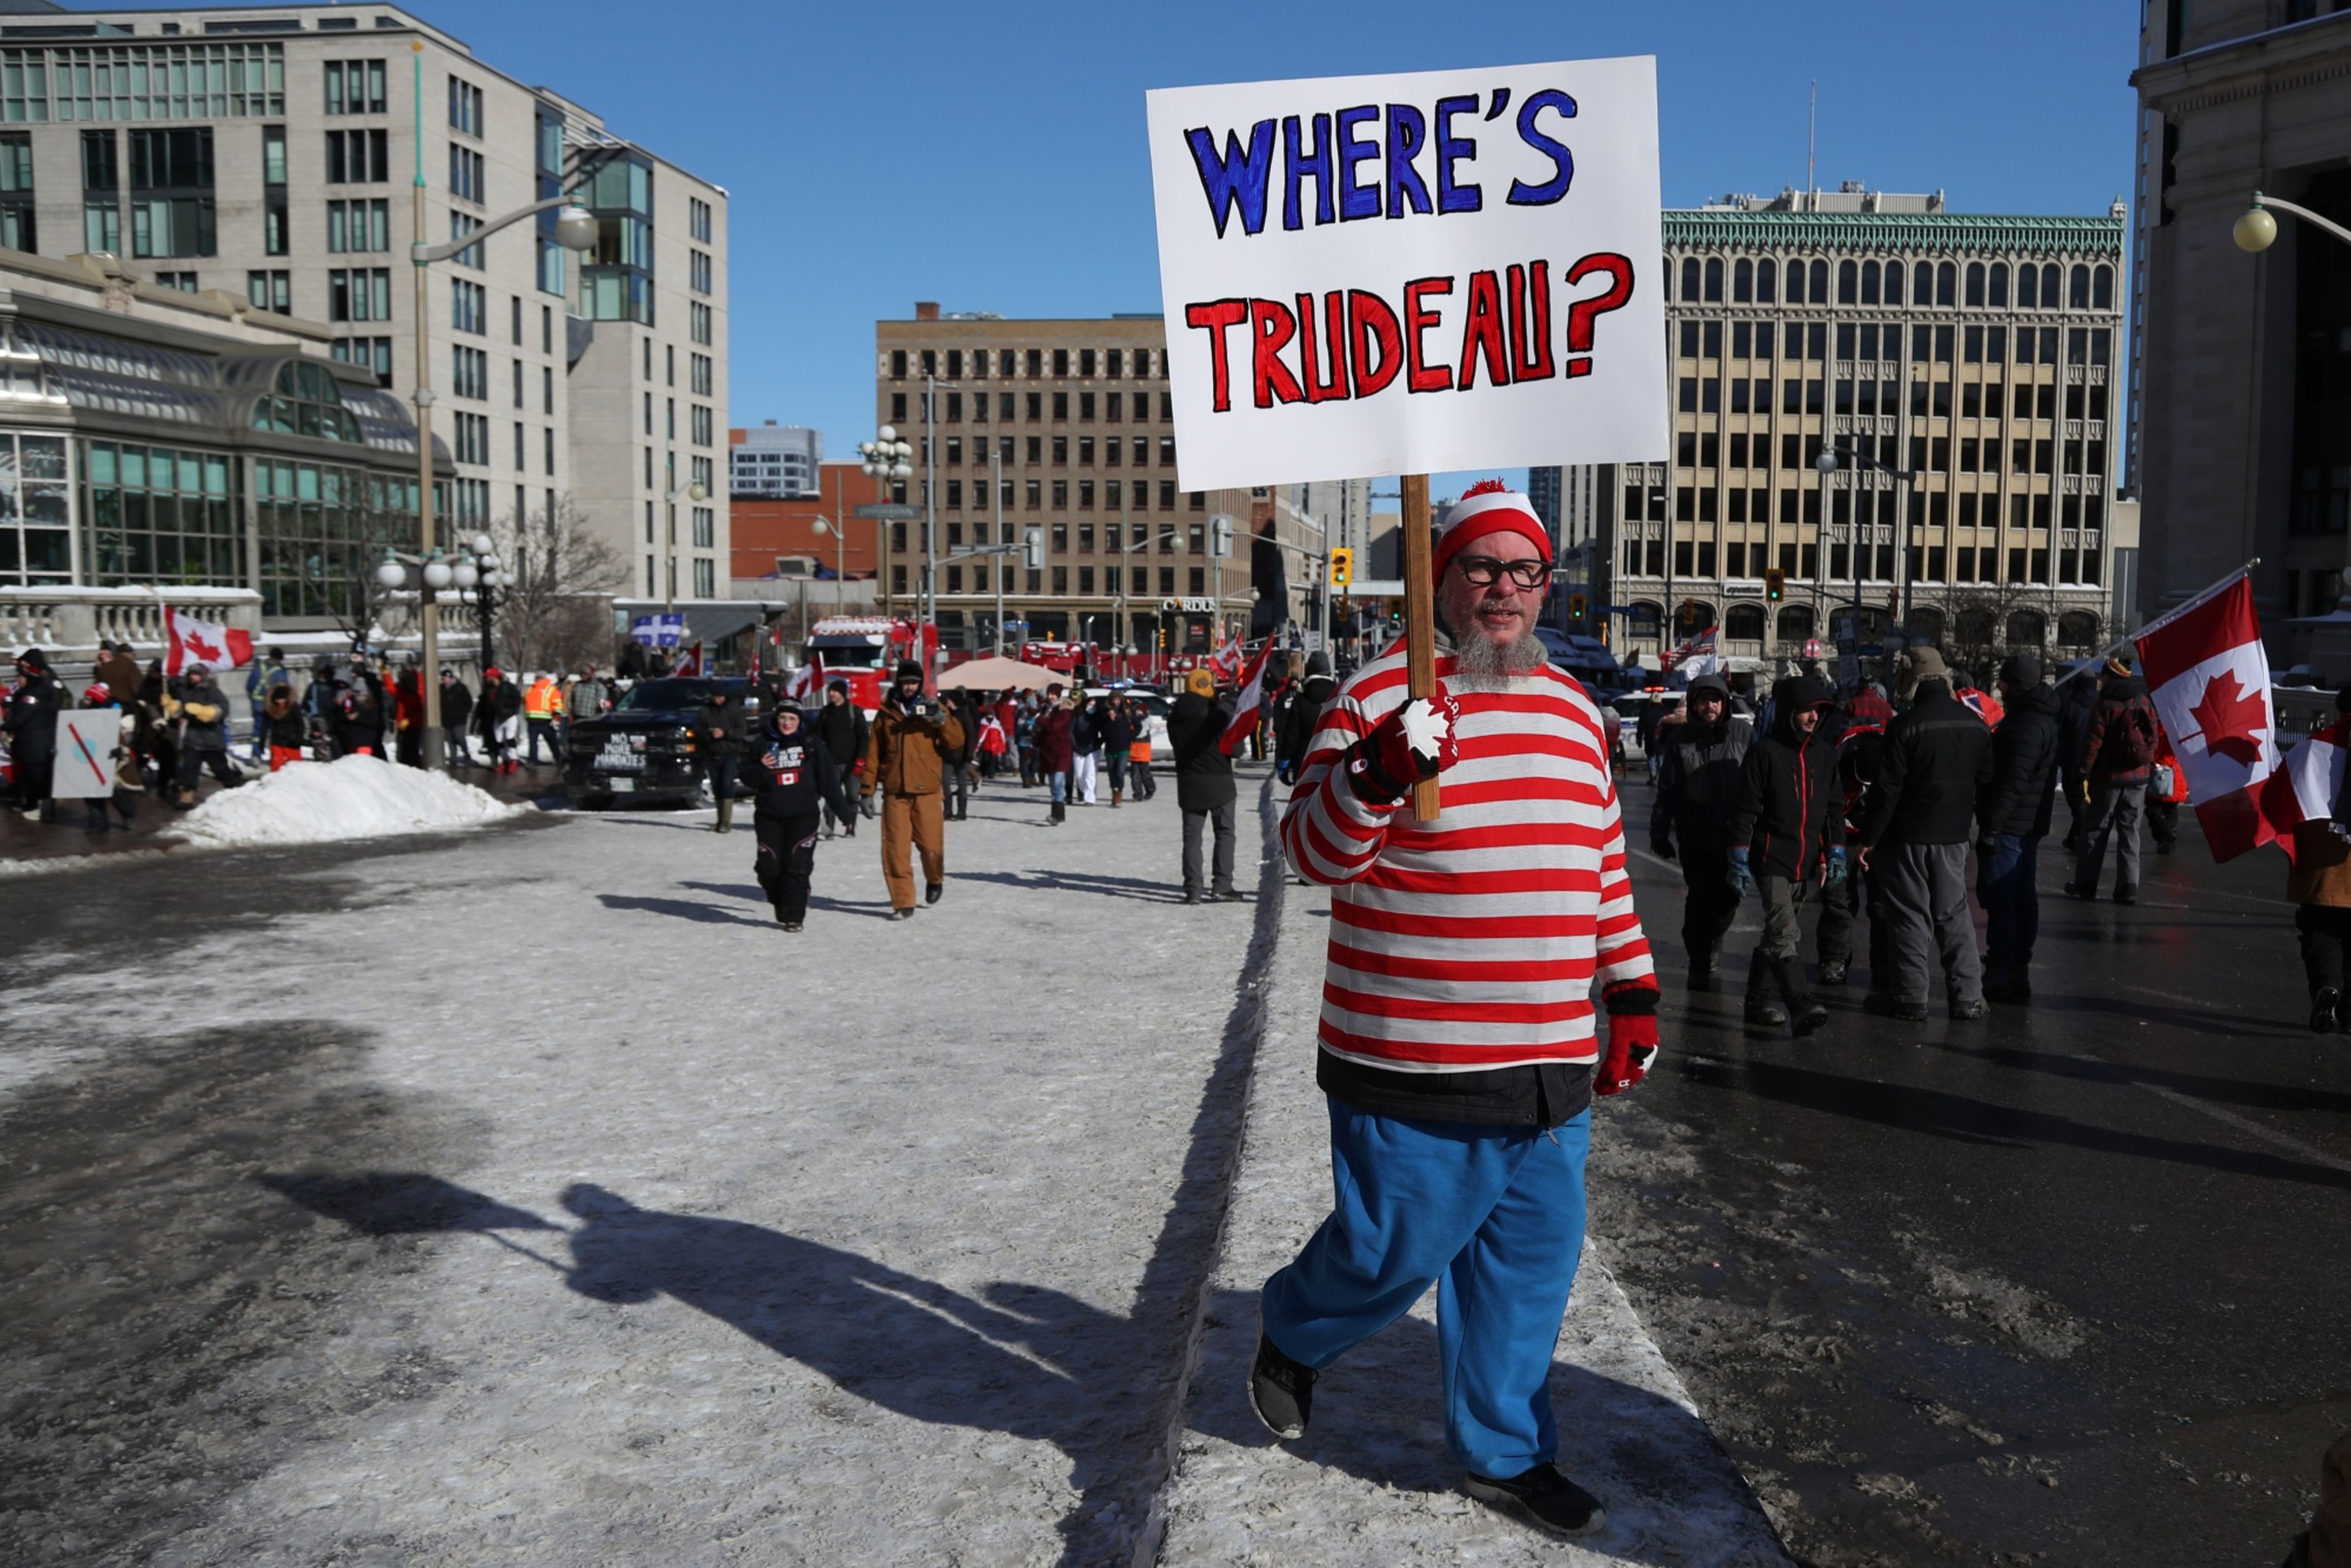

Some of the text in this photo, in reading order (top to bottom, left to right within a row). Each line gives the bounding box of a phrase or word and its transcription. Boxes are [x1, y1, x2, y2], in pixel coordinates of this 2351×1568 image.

[1183, 88, 1578, 239] WHERE'S
[1185, 252, 1635, 413] TRUDEAU?
[611, 732, 629, 744] NO
[604, 743, 632, 754] MORE
[593, 753, 647, 768] MANDATES
